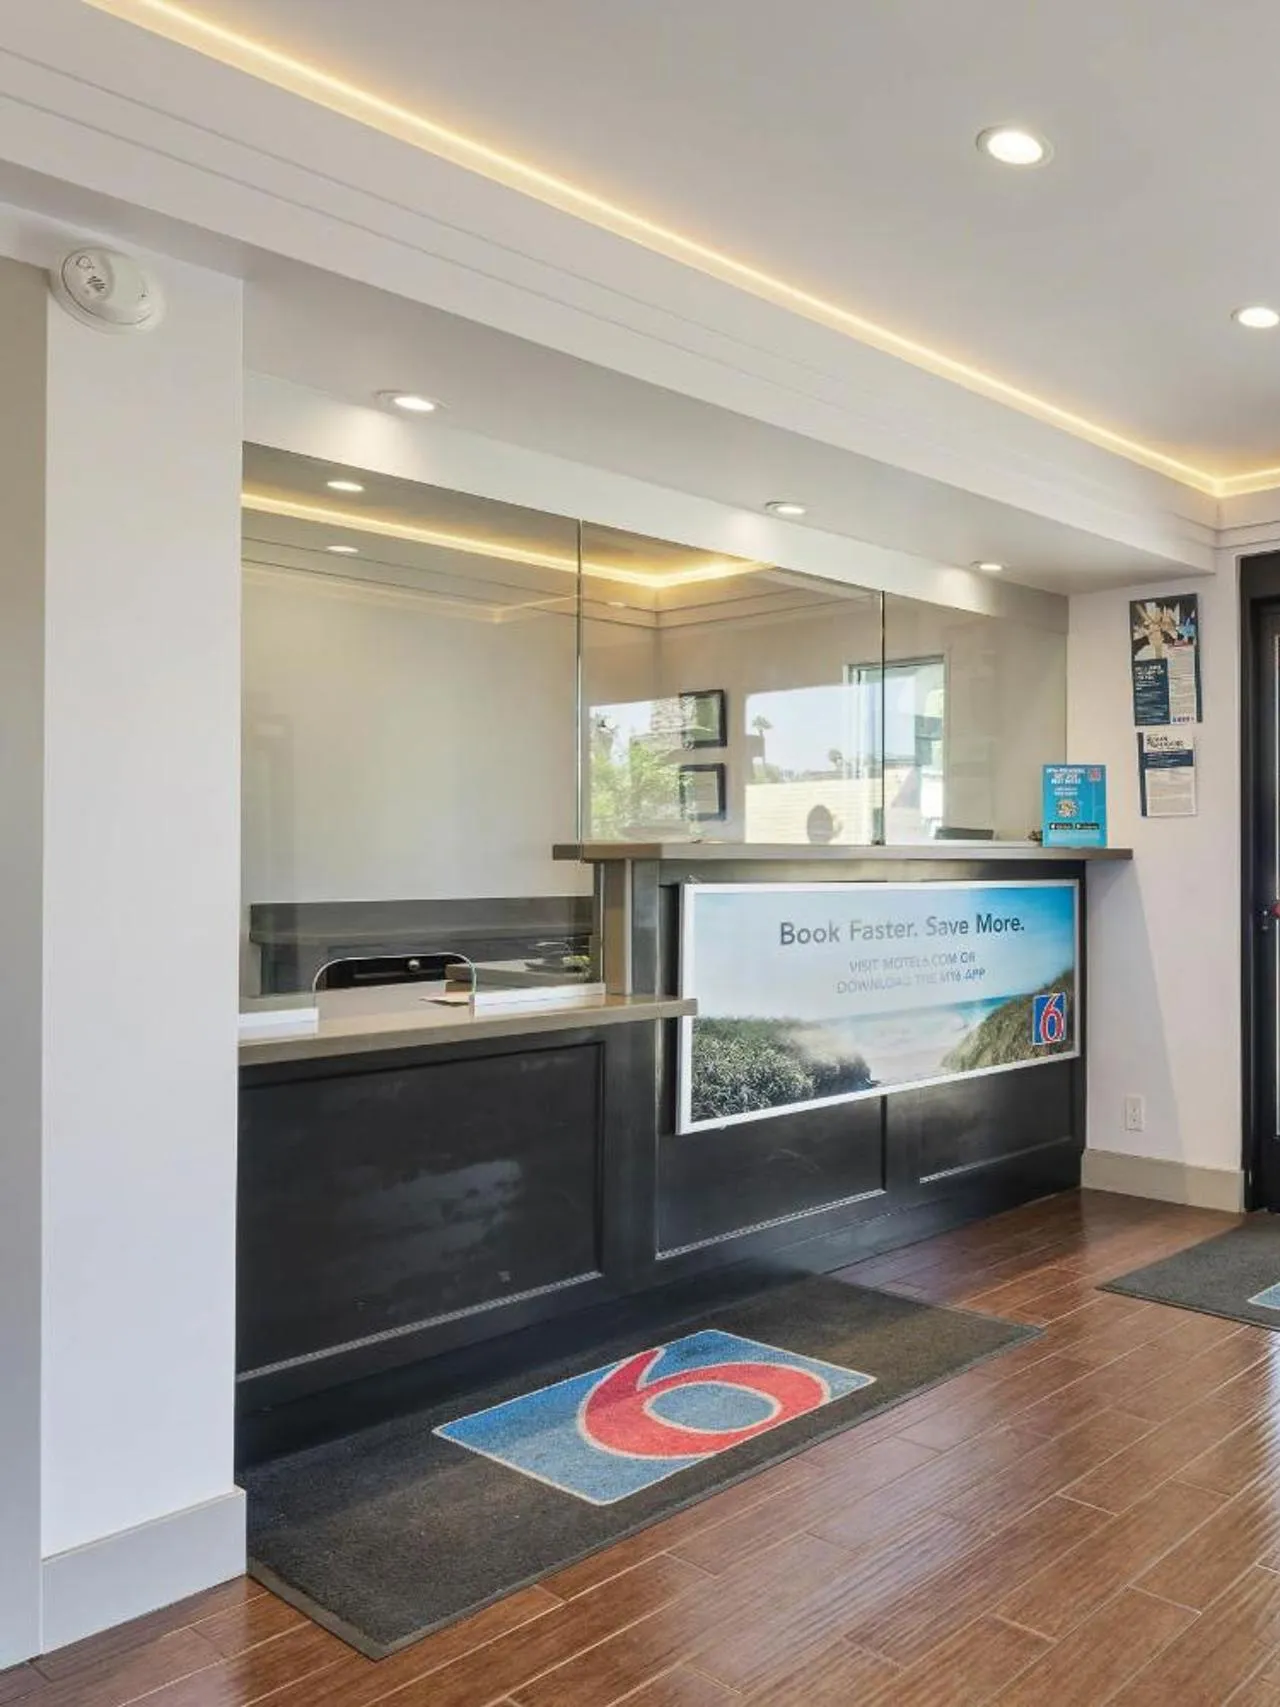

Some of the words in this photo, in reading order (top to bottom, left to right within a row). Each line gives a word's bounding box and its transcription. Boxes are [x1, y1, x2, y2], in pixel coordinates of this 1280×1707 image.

[779, 919, 841, 946] Book
[849, 919, 919, 942] Faster.
[925, 915, 969, 937] Save
[975, 912, 1025, 934] More.
[849, 959, 879, 973] VISIT
[964, 967, 986, 980] APP
[1040, 993, 1065, 1043] 6
[577, 1346, 833, 1460] 6
